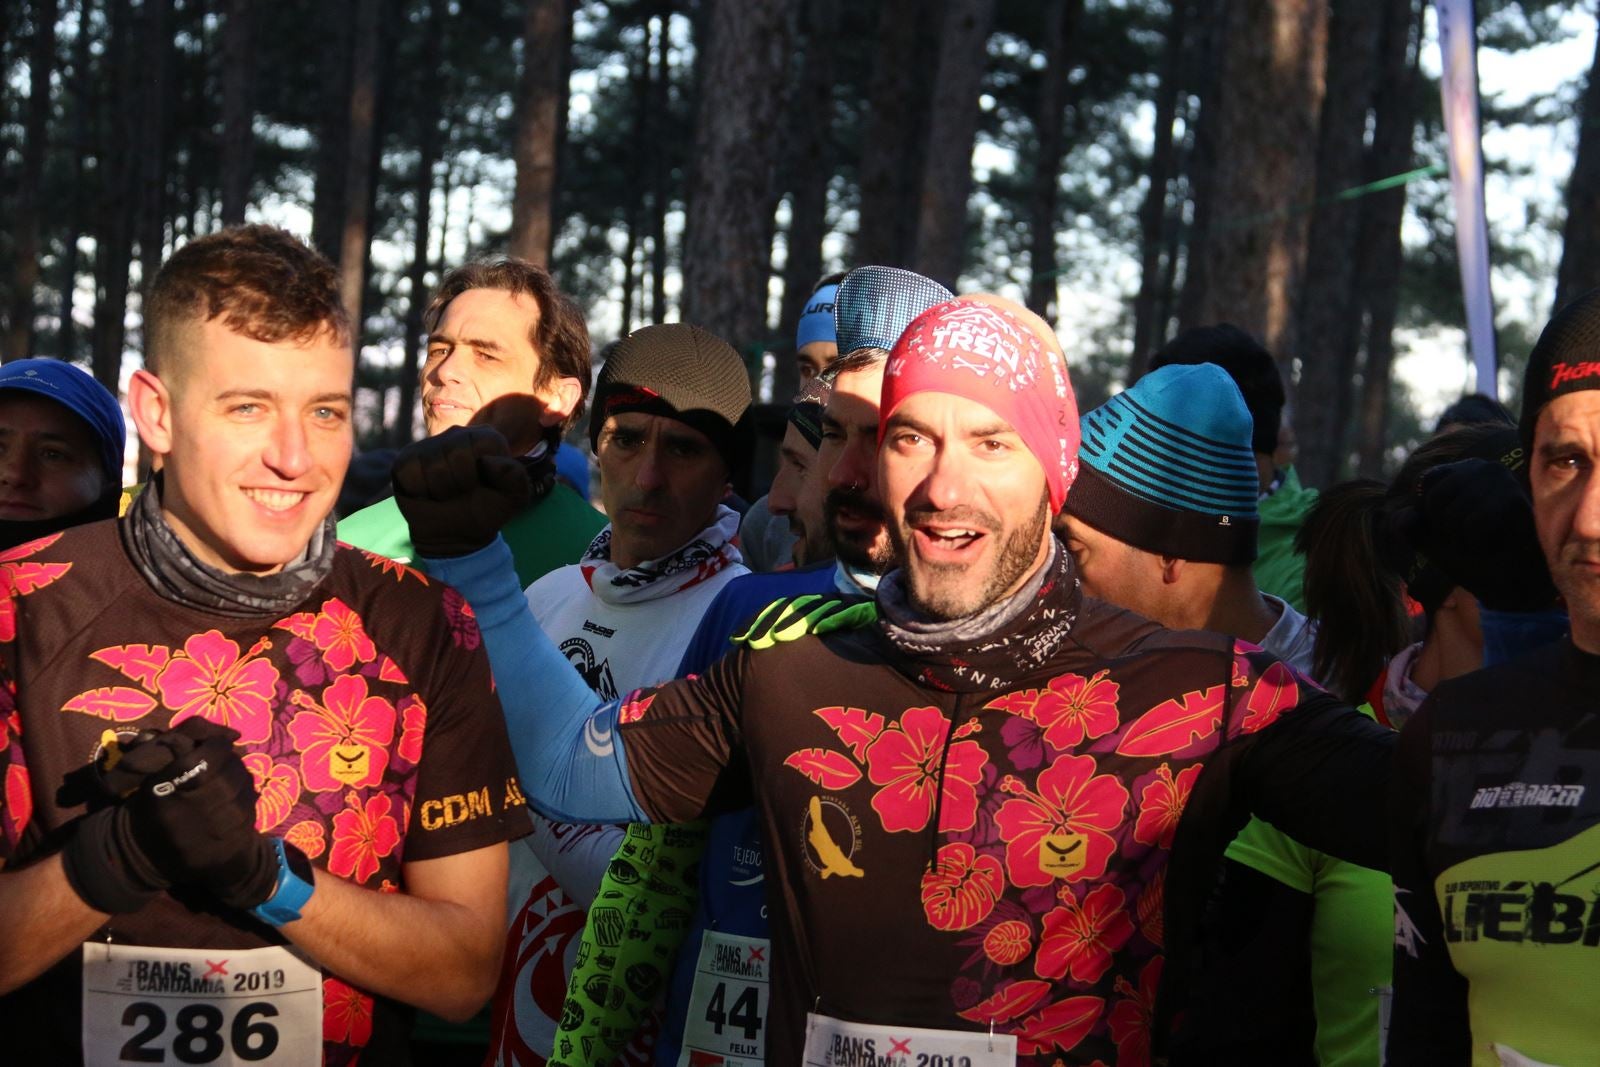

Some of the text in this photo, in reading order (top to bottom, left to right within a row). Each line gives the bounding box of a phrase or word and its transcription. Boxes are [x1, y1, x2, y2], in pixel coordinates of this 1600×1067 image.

[420, 785, 494, 831] CDM
[233, 969, 285, 992] 2019
[119, 1001, 280, 1064] 286
[705, 982, 763, 1040] 44
[729, 1042, 758, 1056] FELIX
